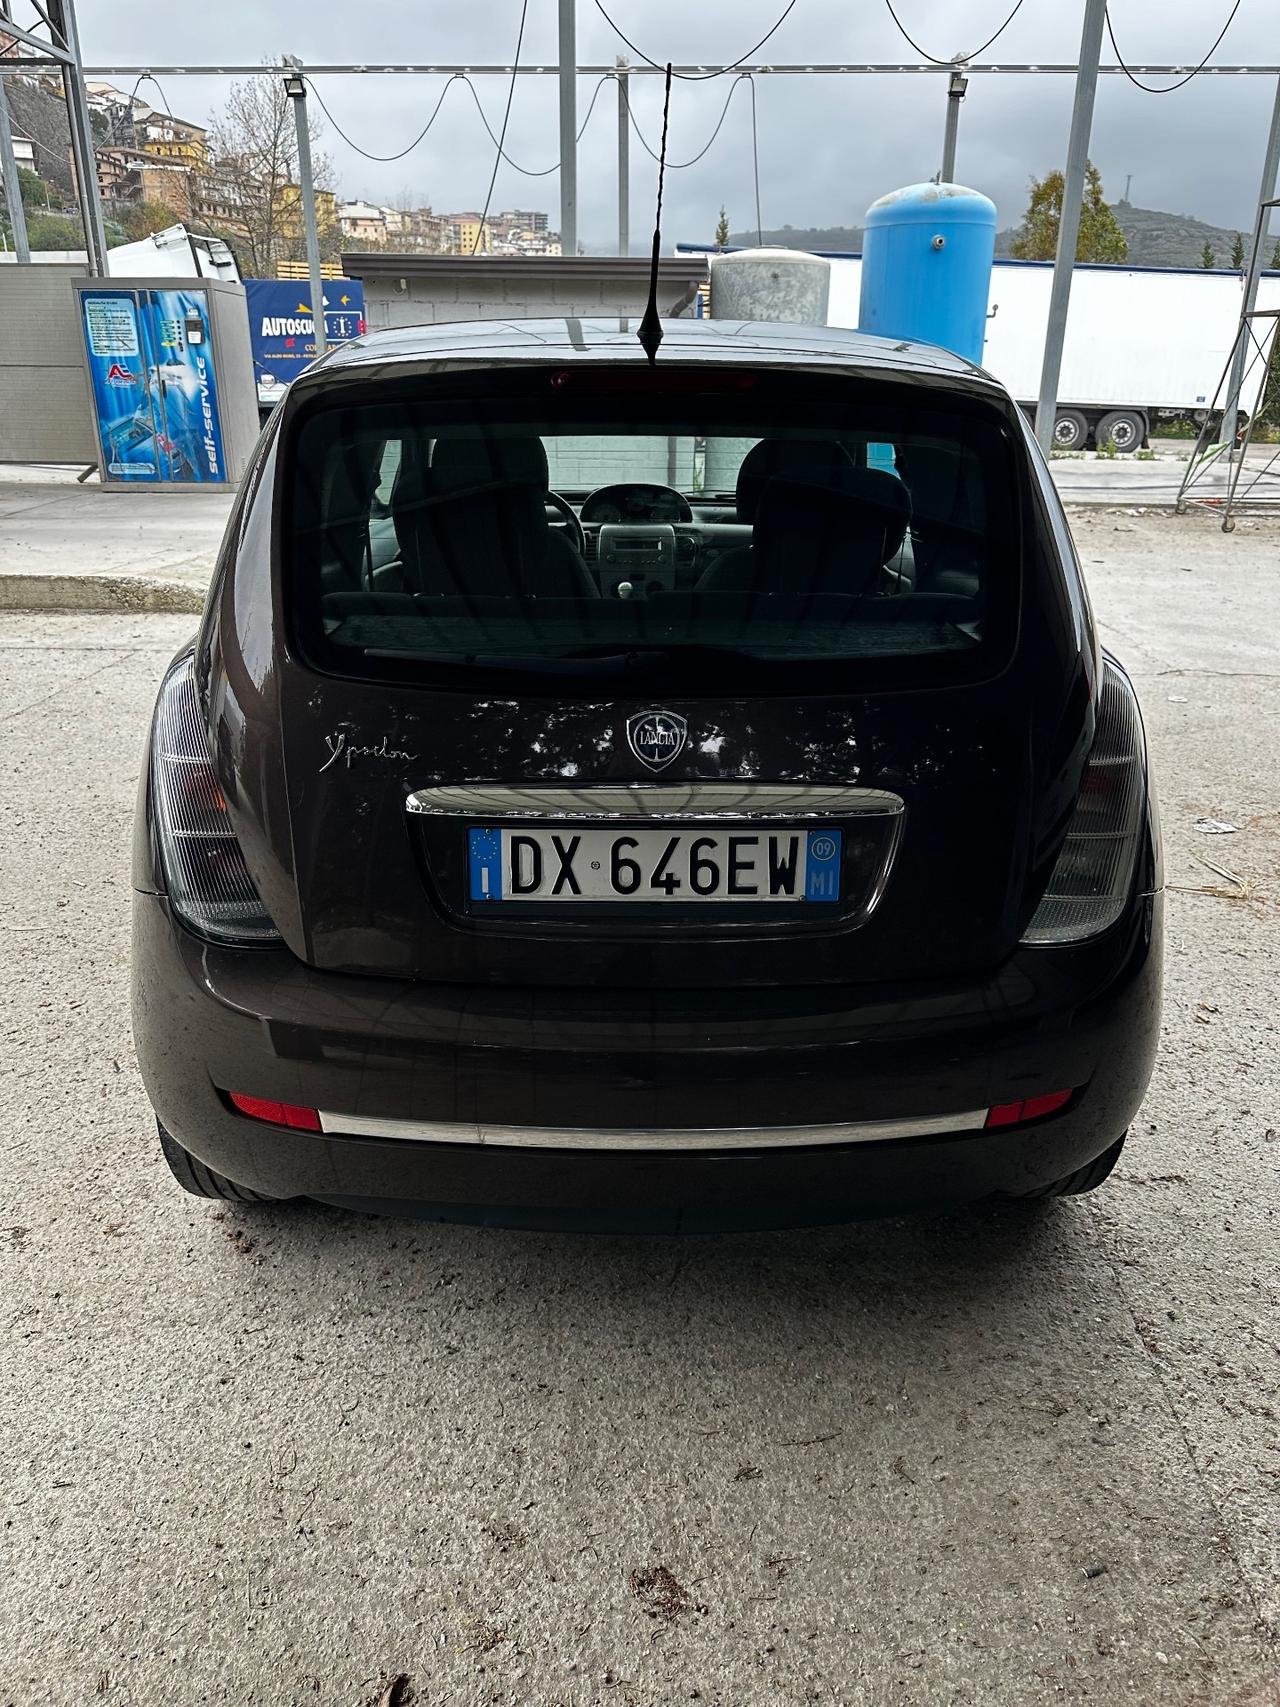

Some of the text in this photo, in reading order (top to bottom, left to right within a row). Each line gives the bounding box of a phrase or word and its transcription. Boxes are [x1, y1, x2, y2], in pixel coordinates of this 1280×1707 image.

[197, 356, 219, 474] self-service
[640, 731, 676, 746] LANCIA
[816, 842, 831, 856] 09
[510, 835, 800, 896] DX 646EW
[481, 867, 489, 894] I
[810, 870, 834, 896] MI
